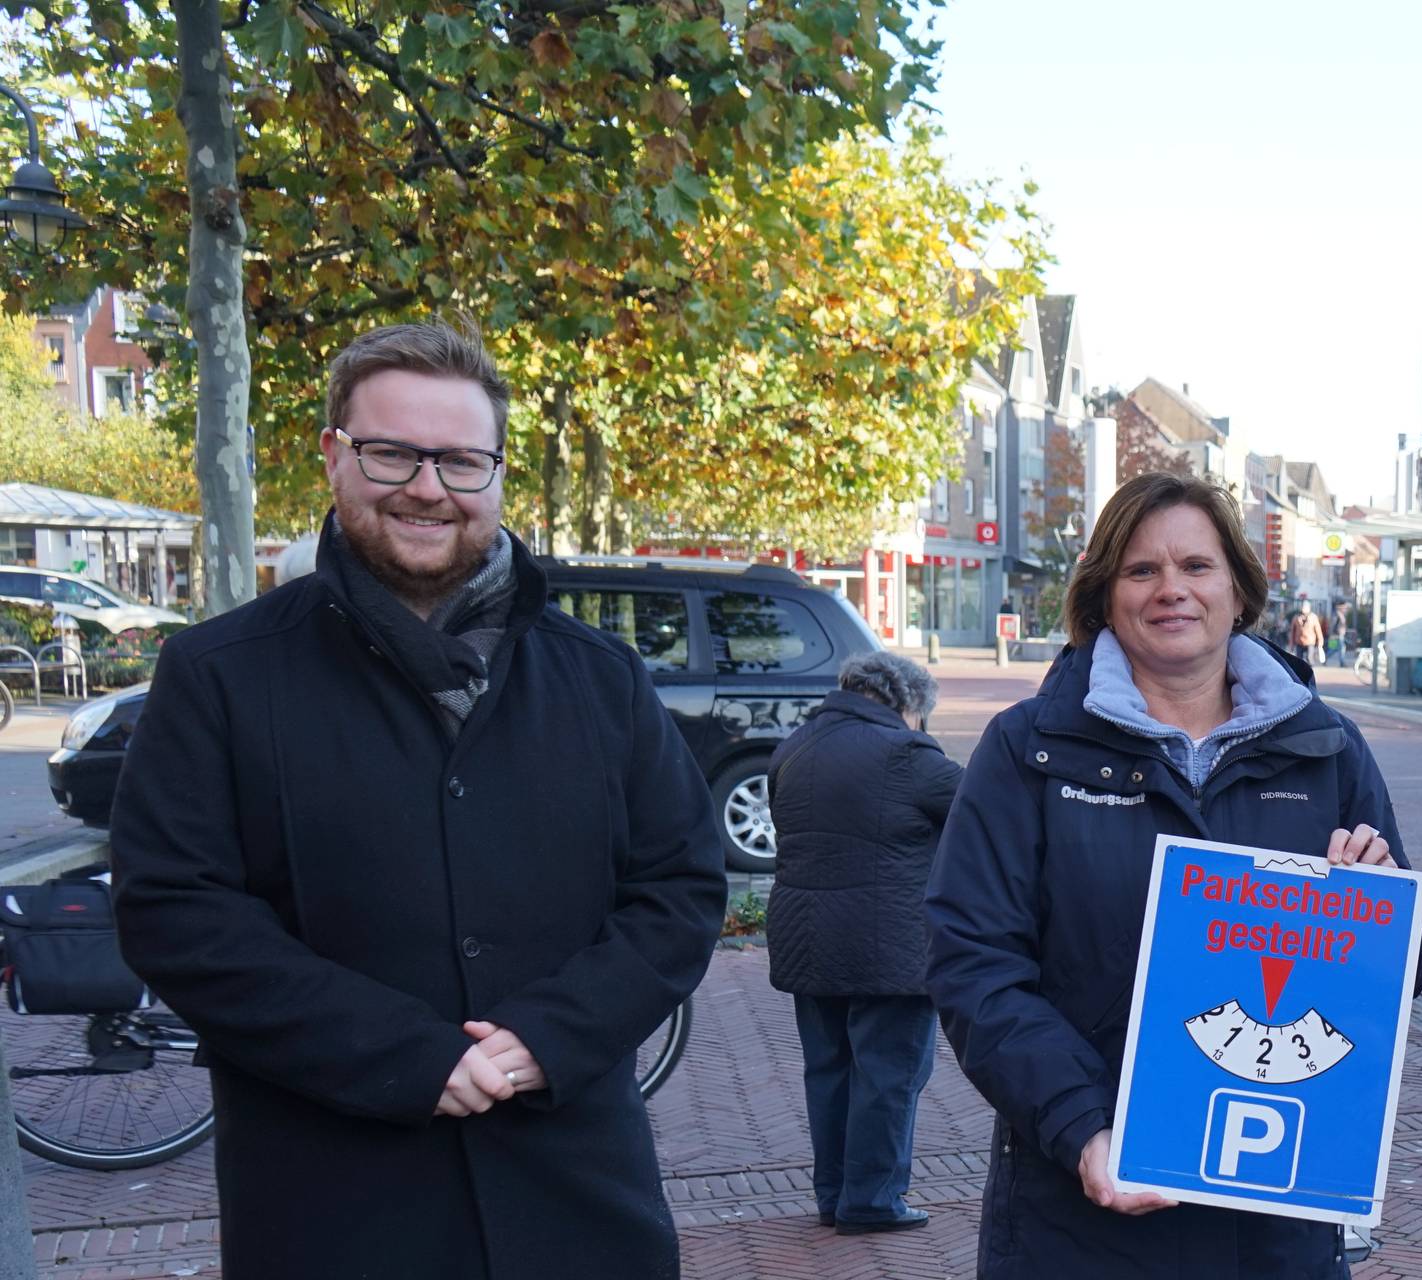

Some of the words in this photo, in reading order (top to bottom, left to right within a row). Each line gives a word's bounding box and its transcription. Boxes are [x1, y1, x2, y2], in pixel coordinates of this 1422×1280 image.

[1061, 784, 1146, 806] Ordnungsamt
[1260, 791, 1309, 801] DIDRIKSONS
[1181, 863, 1395, 926] Parkscheibe
[1205, 919, 1356, 964] gestellt?
[1212, 1048, 1224, 1062] 13
[1255, 1067, 1267, 1080] 14
[1305, 1060, 1318, 1074] 15
[1223, 1026, 1244, 1049] 1
[1255, 1037, 1274, 1066] 2
[1291, 1033, 1312, 1060] 3
[1218, 1100, 1286, 1177] P
